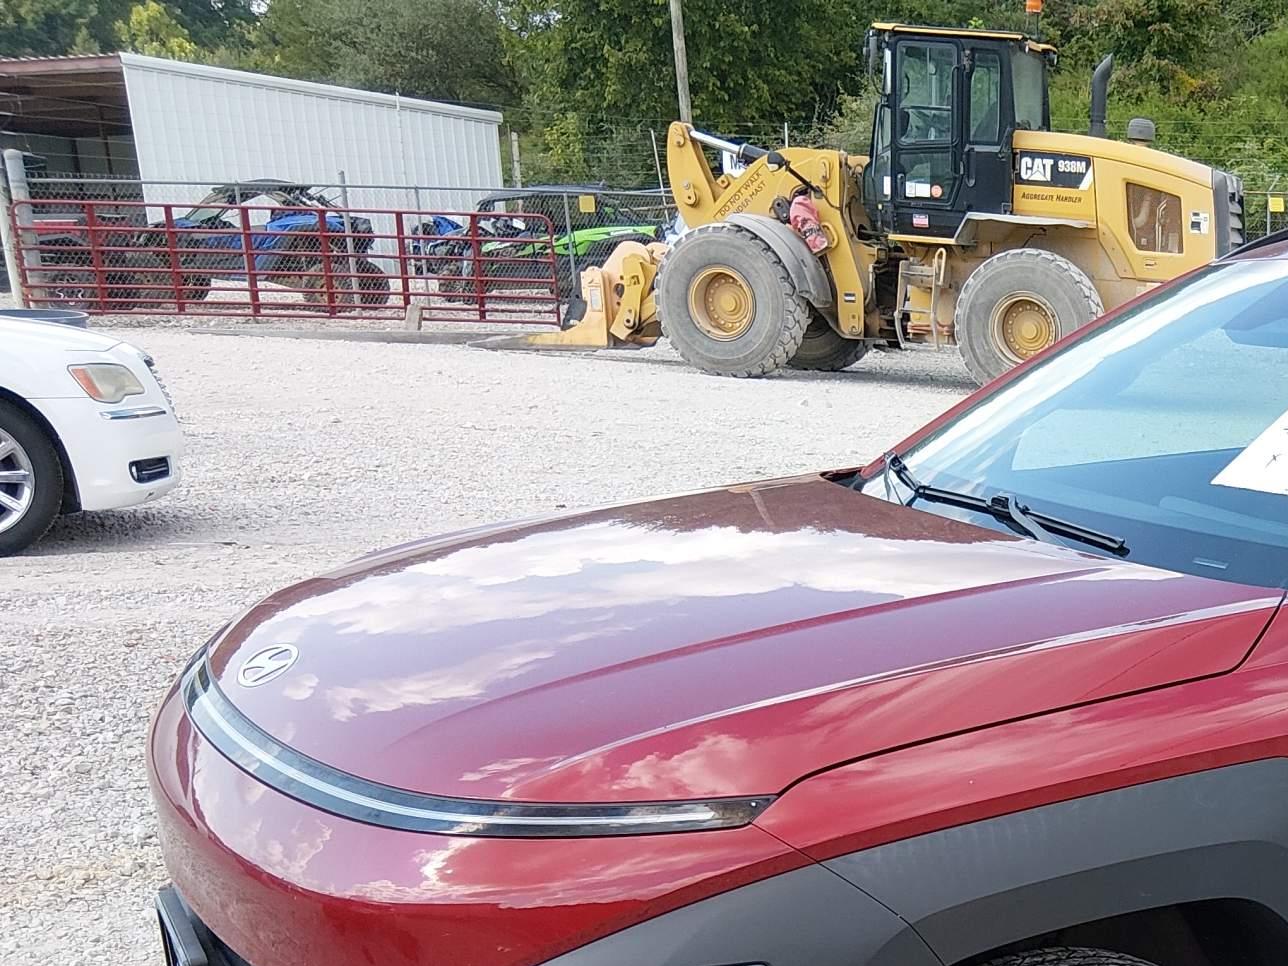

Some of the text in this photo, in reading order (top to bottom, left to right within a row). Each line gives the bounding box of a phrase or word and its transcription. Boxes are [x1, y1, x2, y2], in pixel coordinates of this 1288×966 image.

[1020, 157, 1087, 181] CAT 938M
[719, 172, 762, 217] DO NOT WALK
[749, 180, 766, 200] MAST
